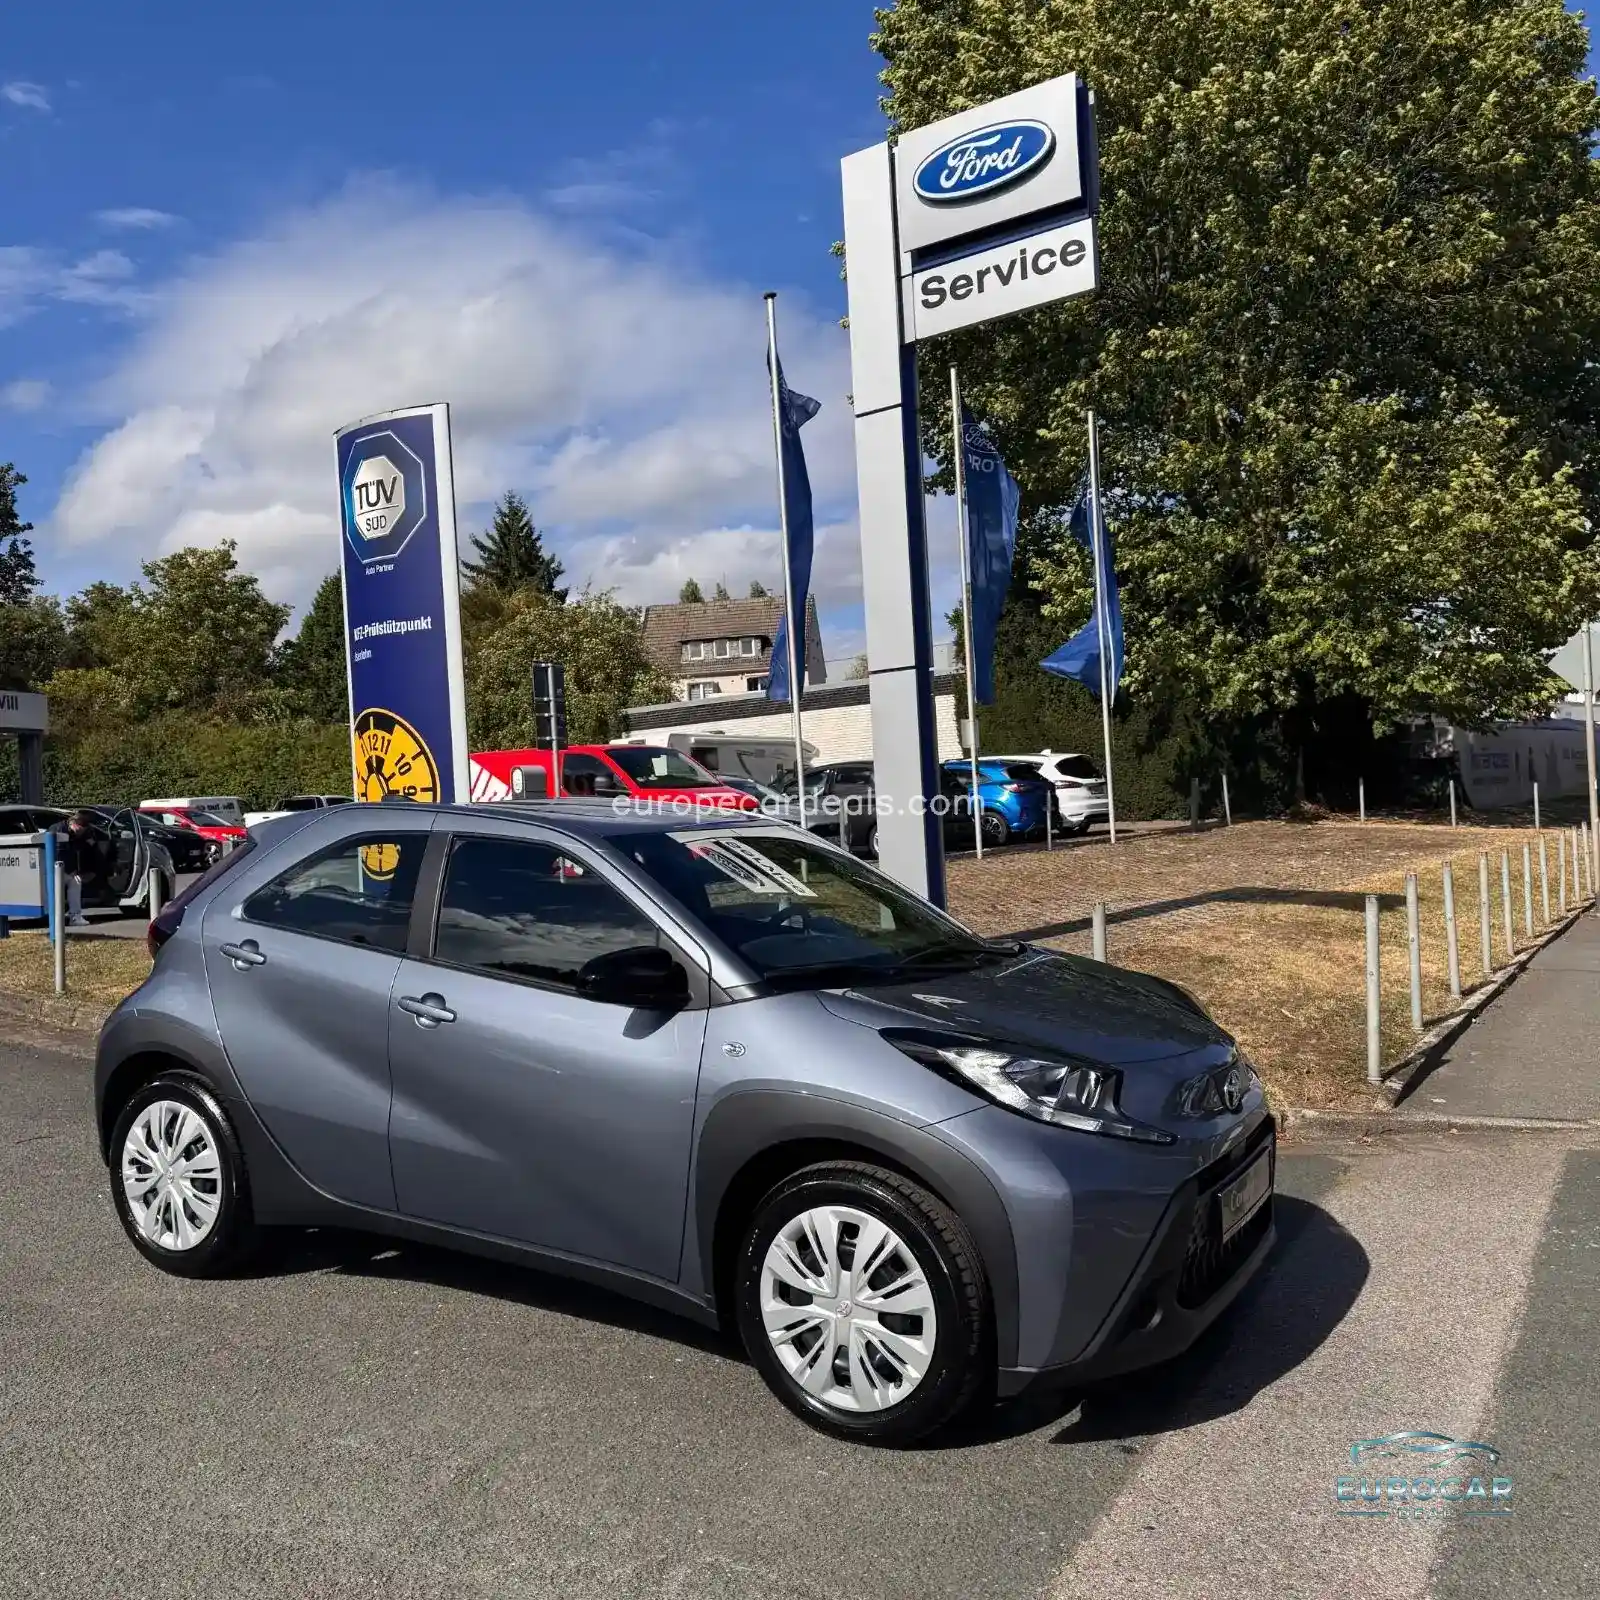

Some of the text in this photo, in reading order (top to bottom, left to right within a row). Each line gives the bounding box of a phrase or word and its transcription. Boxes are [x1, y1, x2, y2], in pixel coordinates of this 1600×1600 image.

[939, 134, 1023, 189] Ford
[921, 239, 1087, 309] Service
[356, 475, 397, 510] TÜV
[376, 563, 394, 573] Partner
